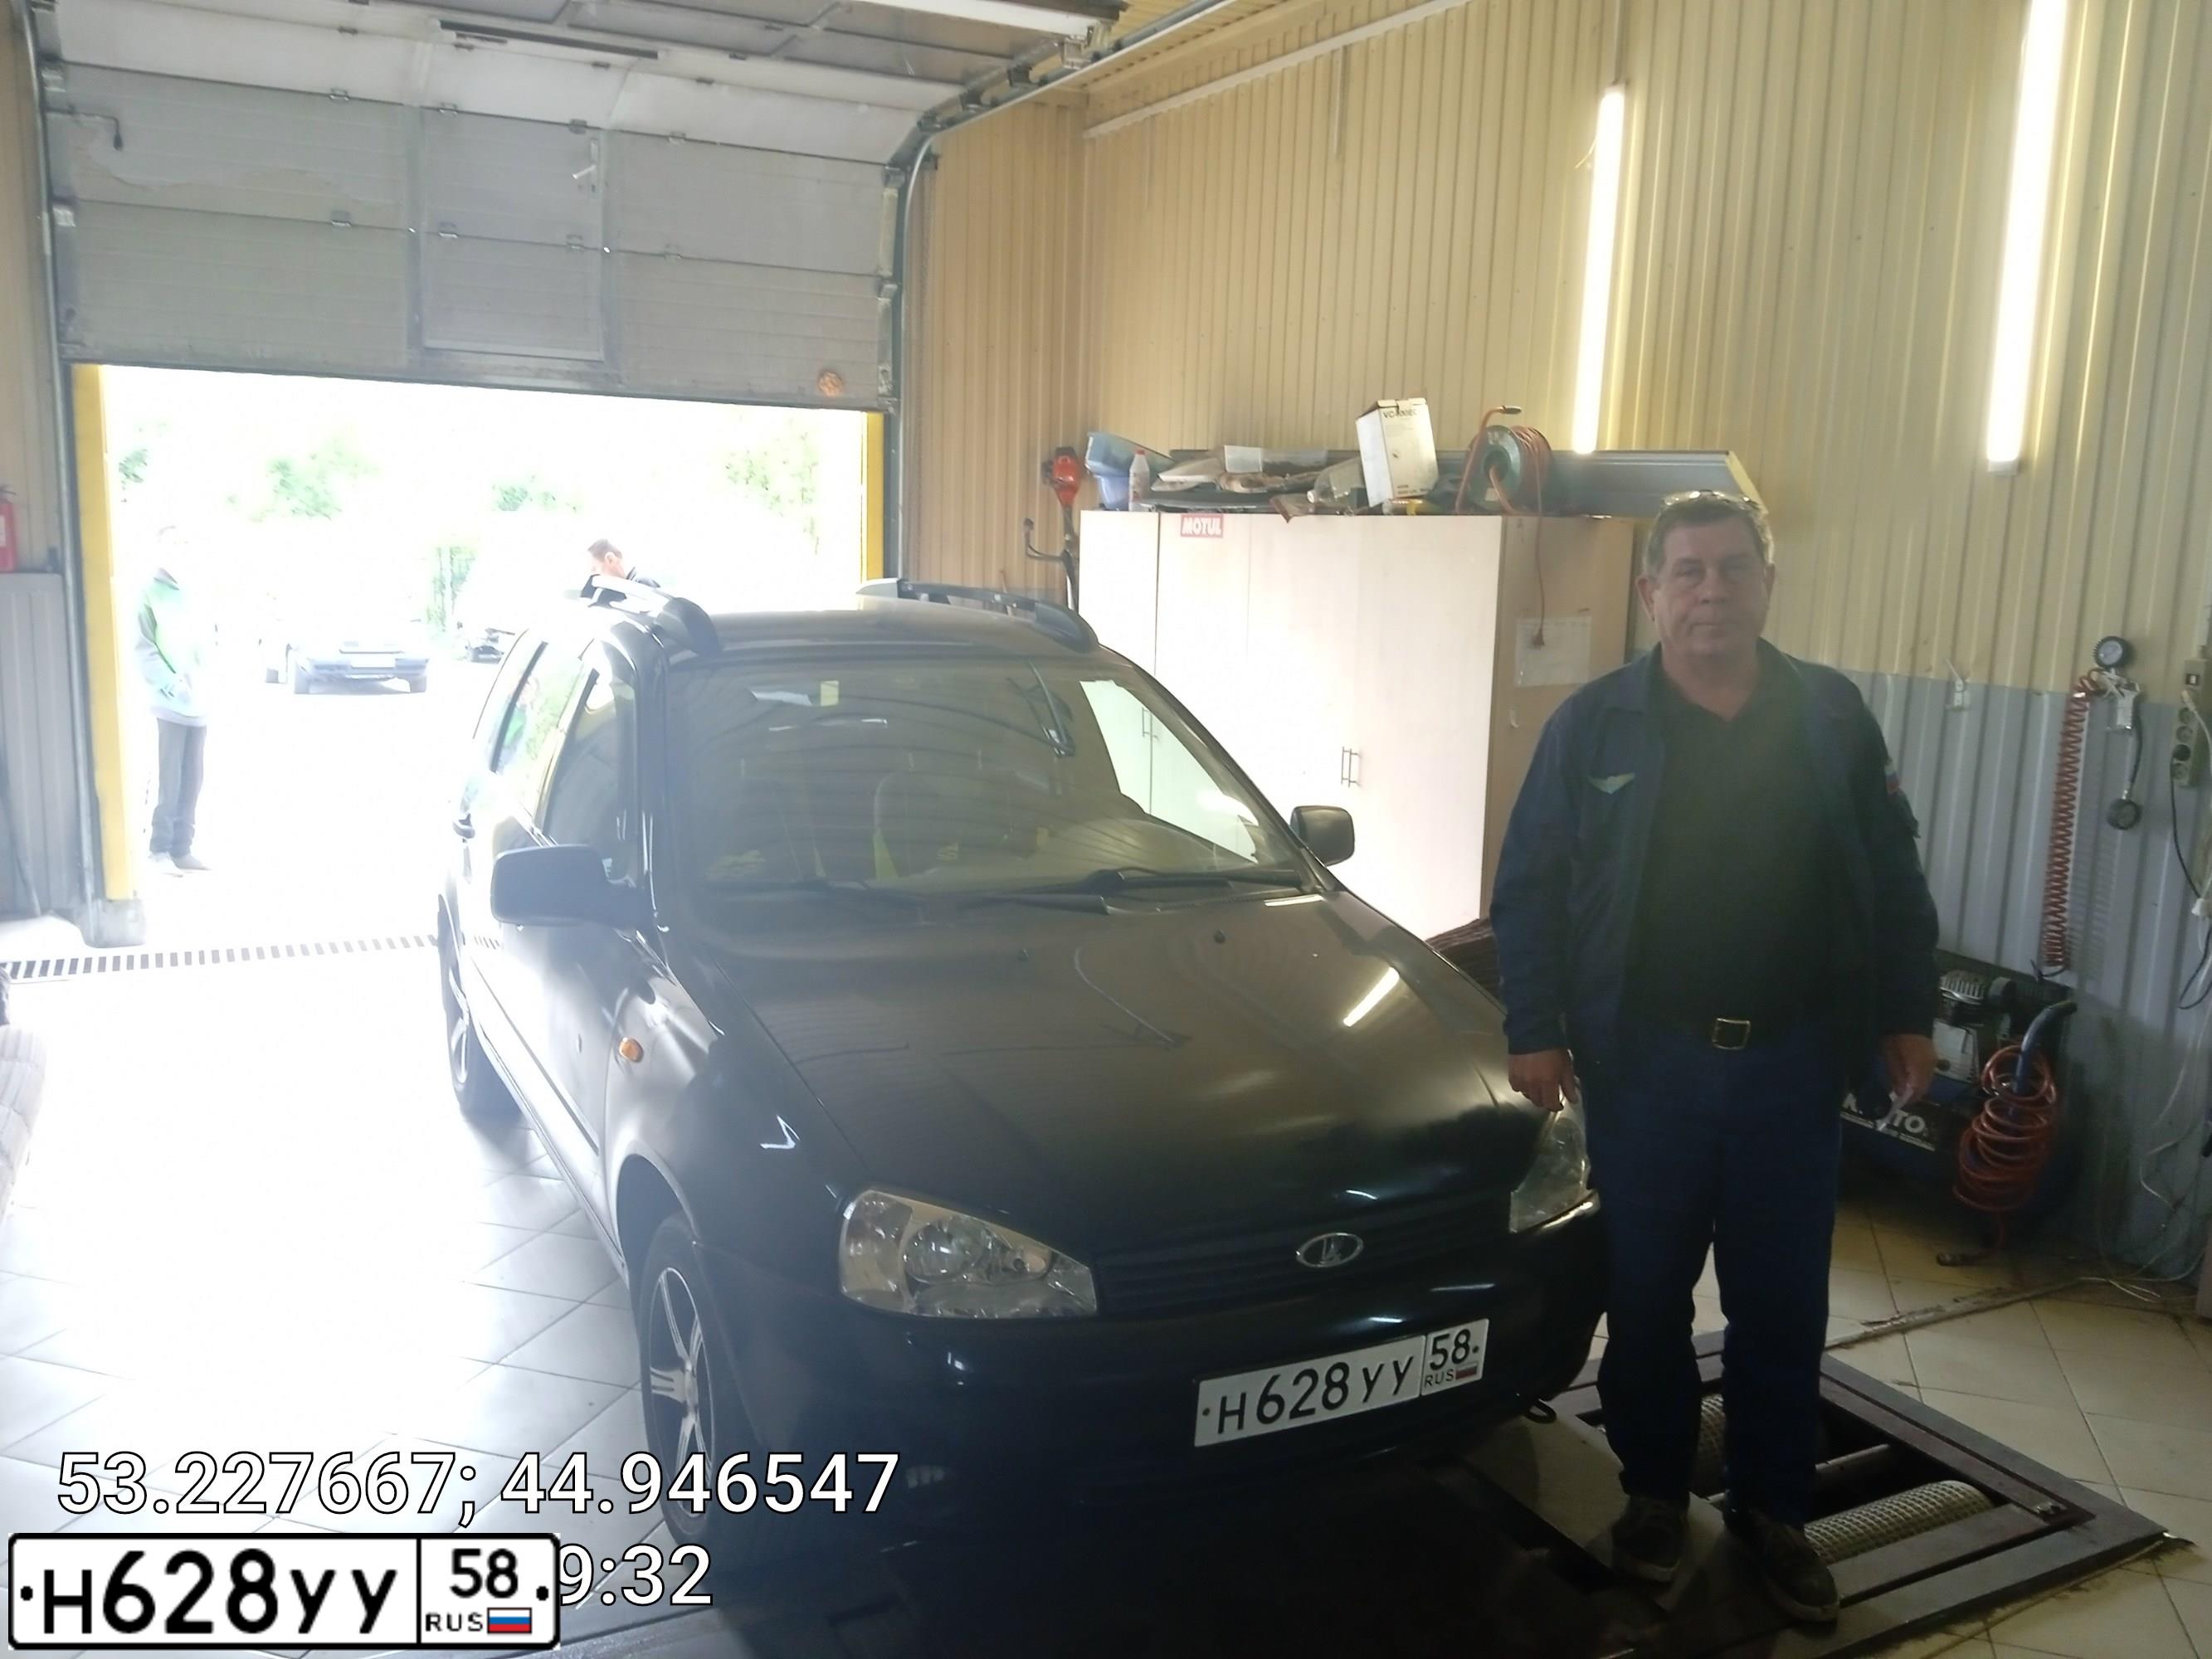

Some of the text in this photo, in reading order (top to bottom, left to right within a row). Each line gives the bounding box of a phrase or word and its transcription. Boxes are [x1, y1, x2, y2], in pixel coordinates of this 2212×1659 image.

[1182, 516, 1222, 536] MOTUL
[1430, 1329, 1471, 1370] 58
[1424, 1370, 1454, 1388] RUS
